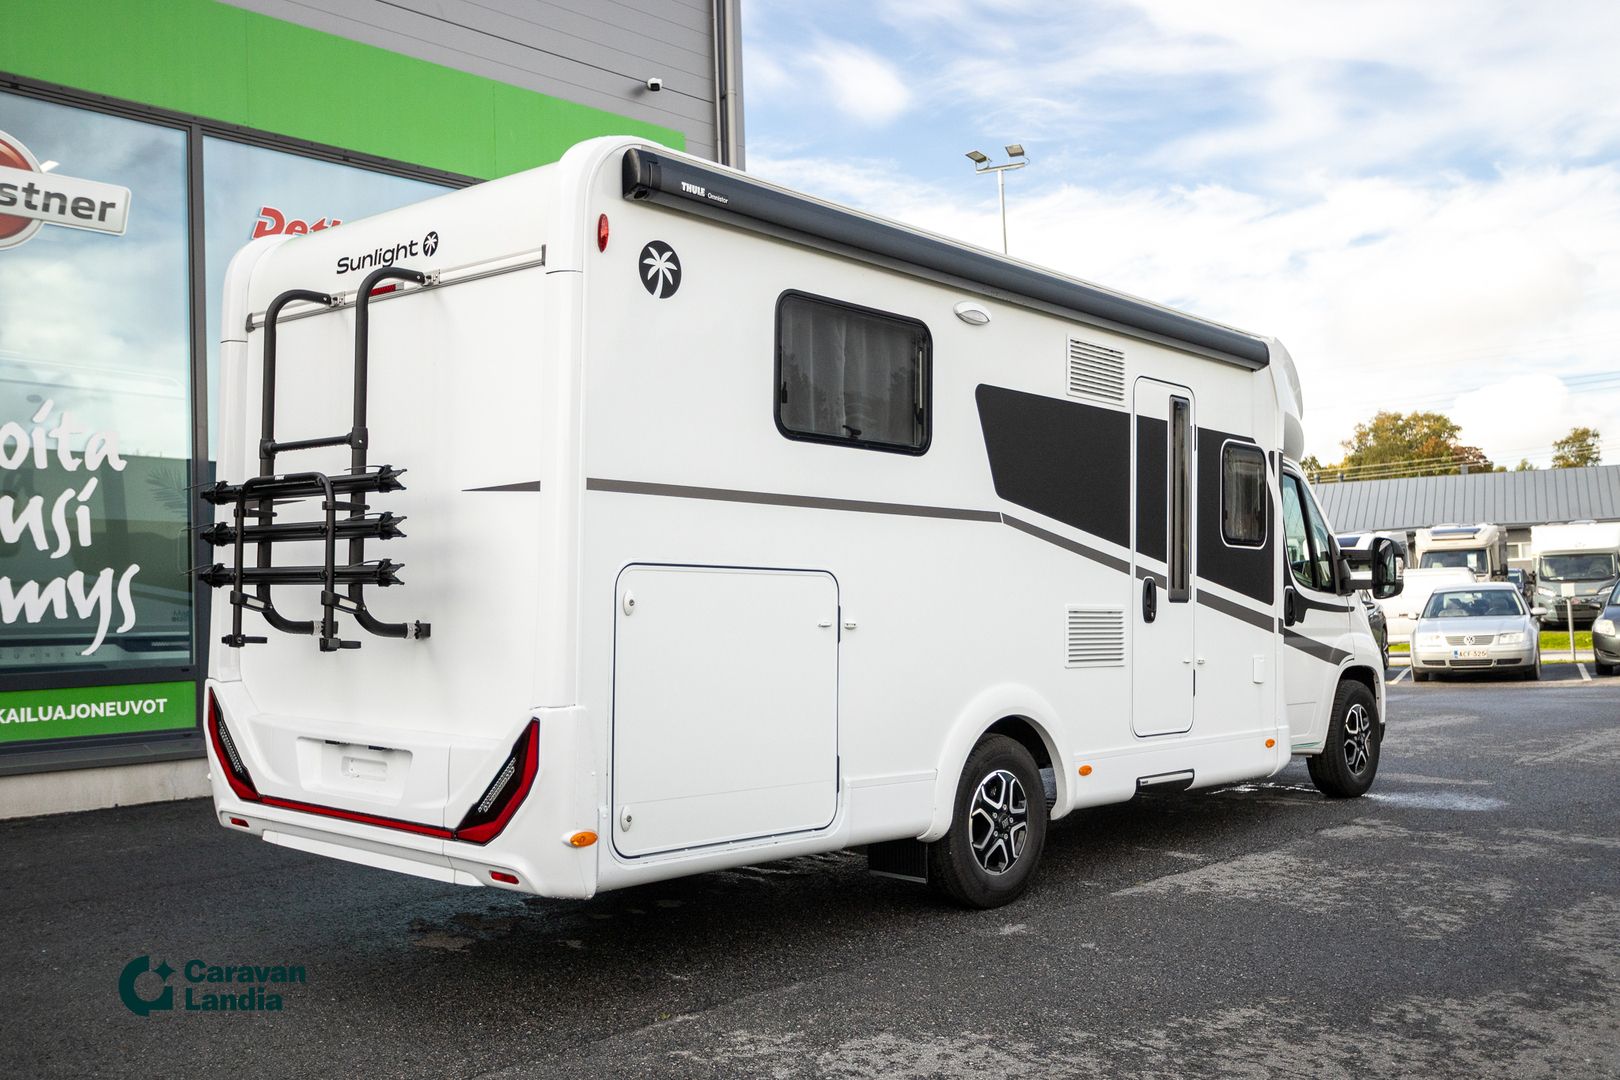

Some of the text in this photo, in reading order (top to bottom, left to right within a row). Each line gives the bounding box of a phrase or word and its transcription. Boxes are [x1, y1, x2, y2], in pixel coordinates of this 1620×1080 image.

[0, 182, 116, 222] stner
[681, 181, 705, 196] THULE
[336, 239, 418, 275] Sunlight
